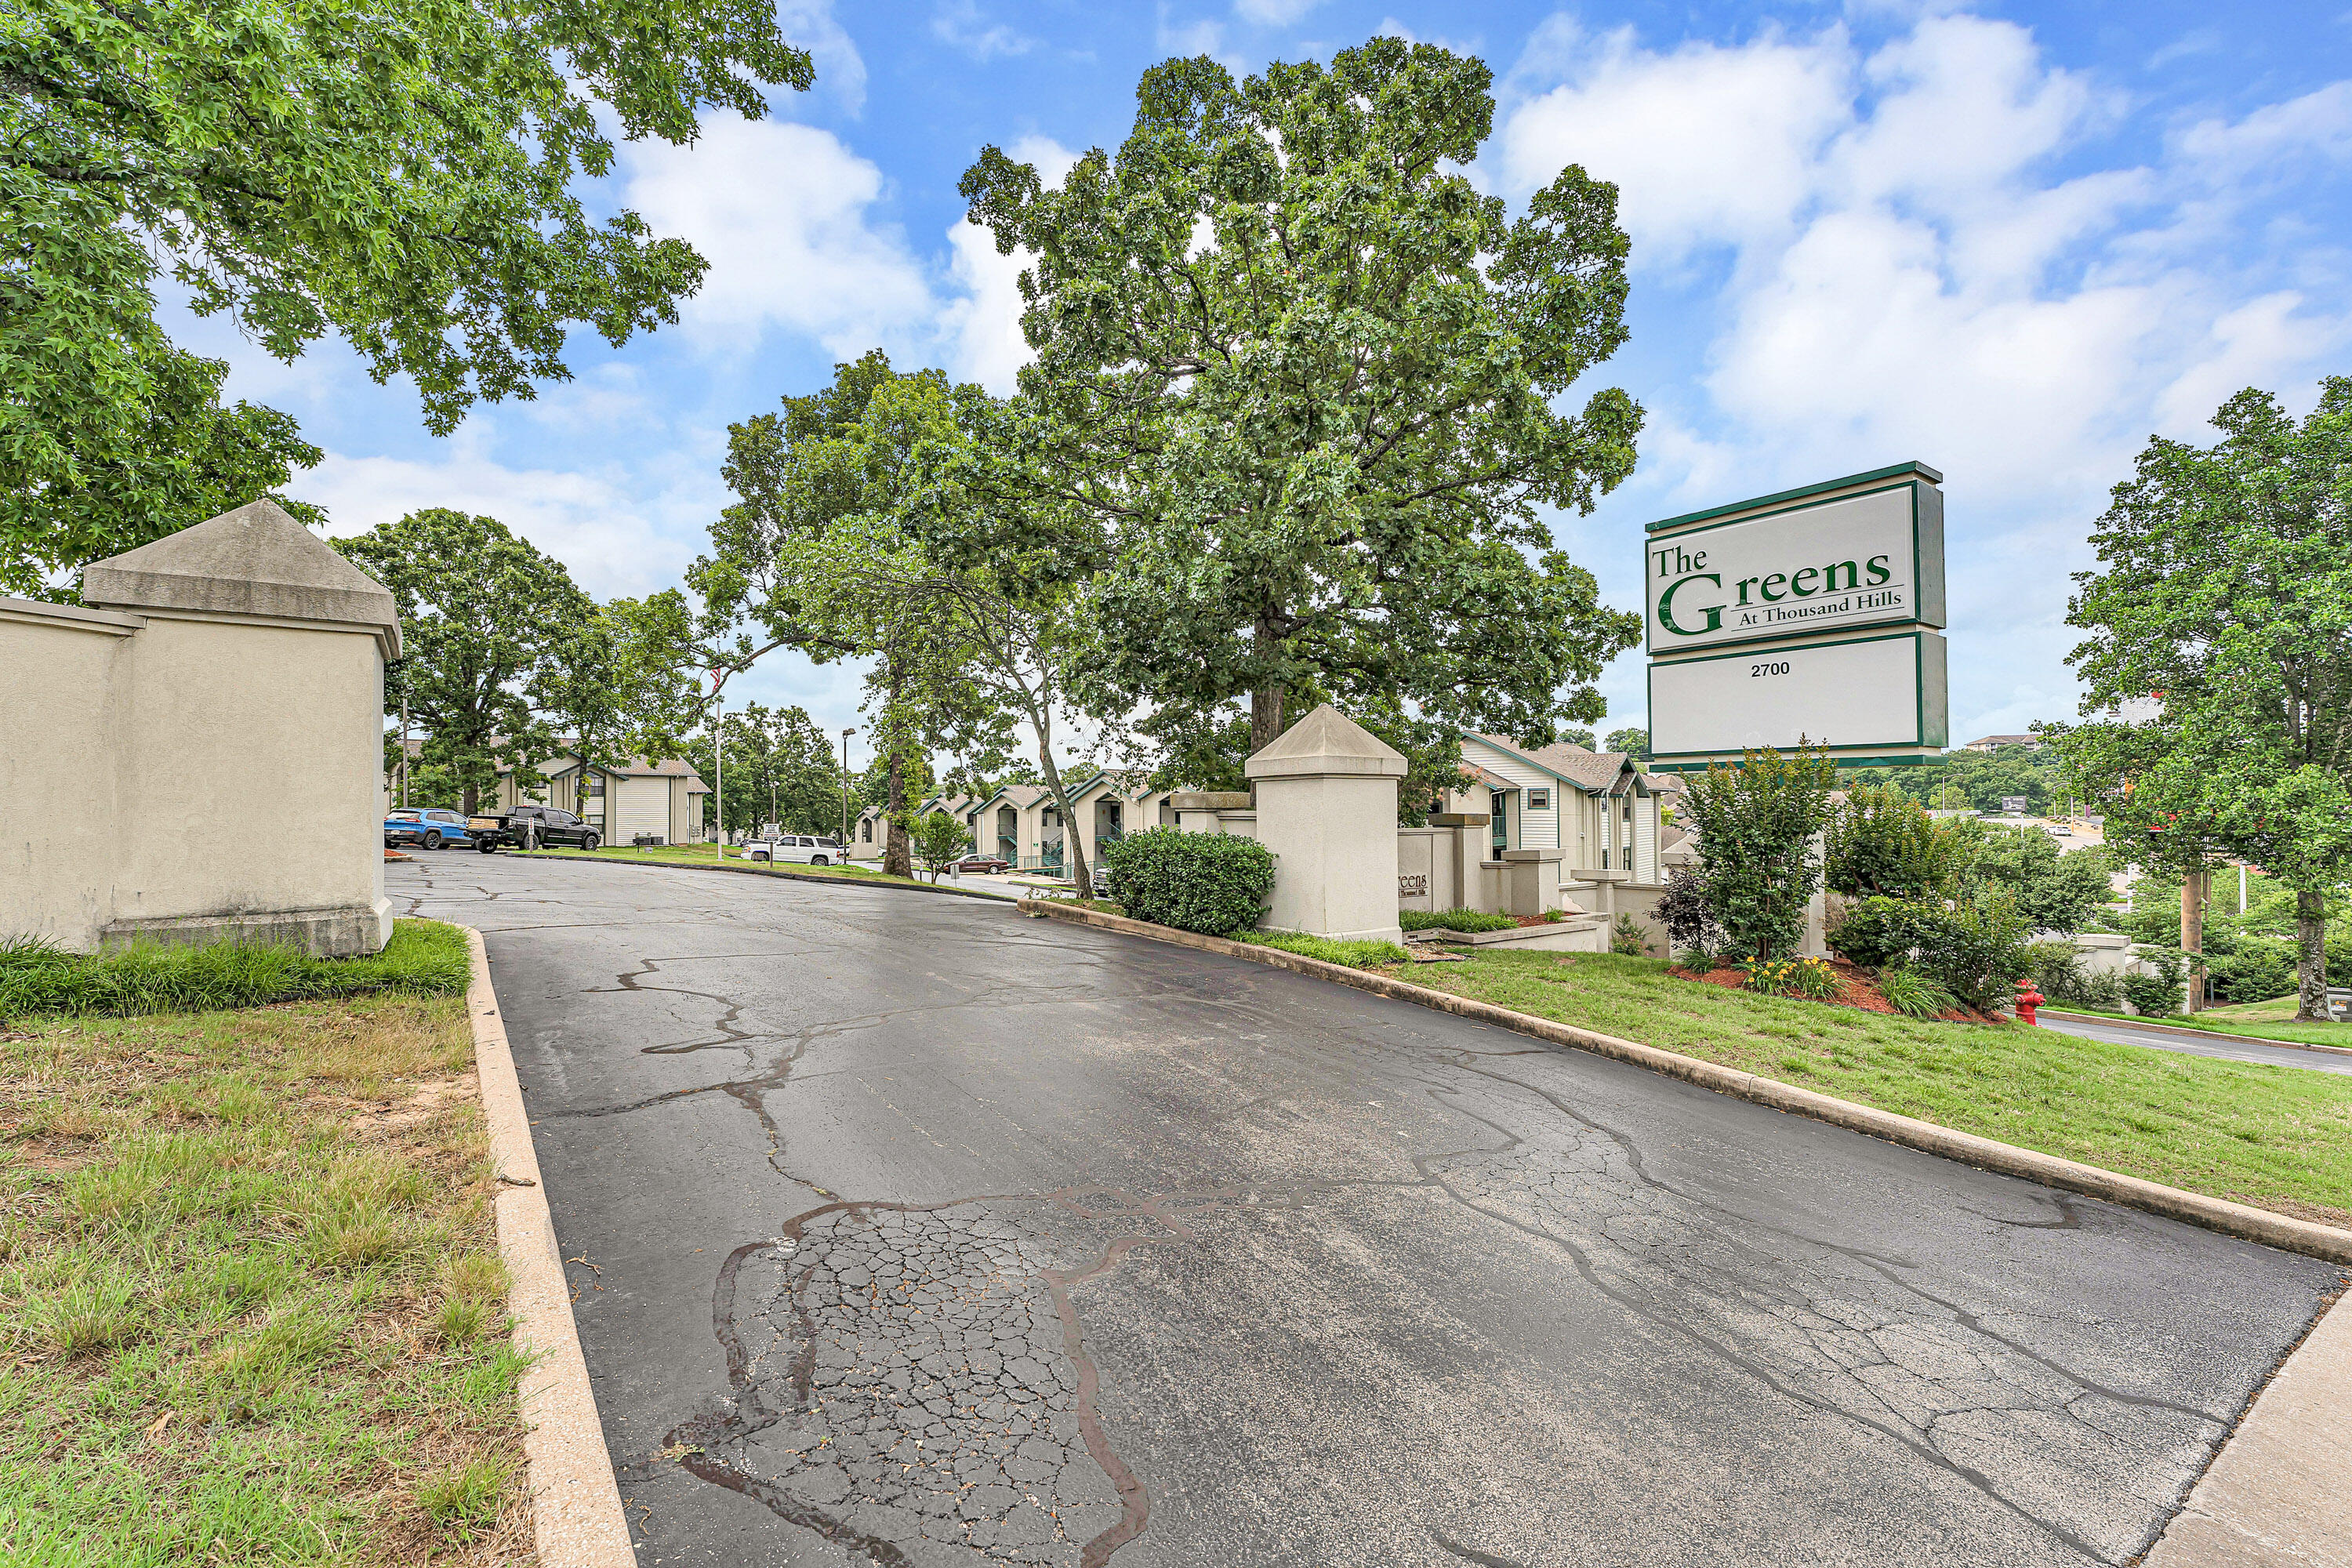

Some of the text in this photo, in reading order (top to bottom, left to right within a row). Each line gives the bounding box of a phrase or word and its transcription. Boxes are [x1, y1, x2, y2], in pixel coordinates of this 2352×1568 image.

[1652, 544, 1708, 578] The
[1657, 554, 1891, 636] Greens
[1738, 590, 1902, 626] At Thousand Hills
[1751, 662, 1791, 677] 2700
